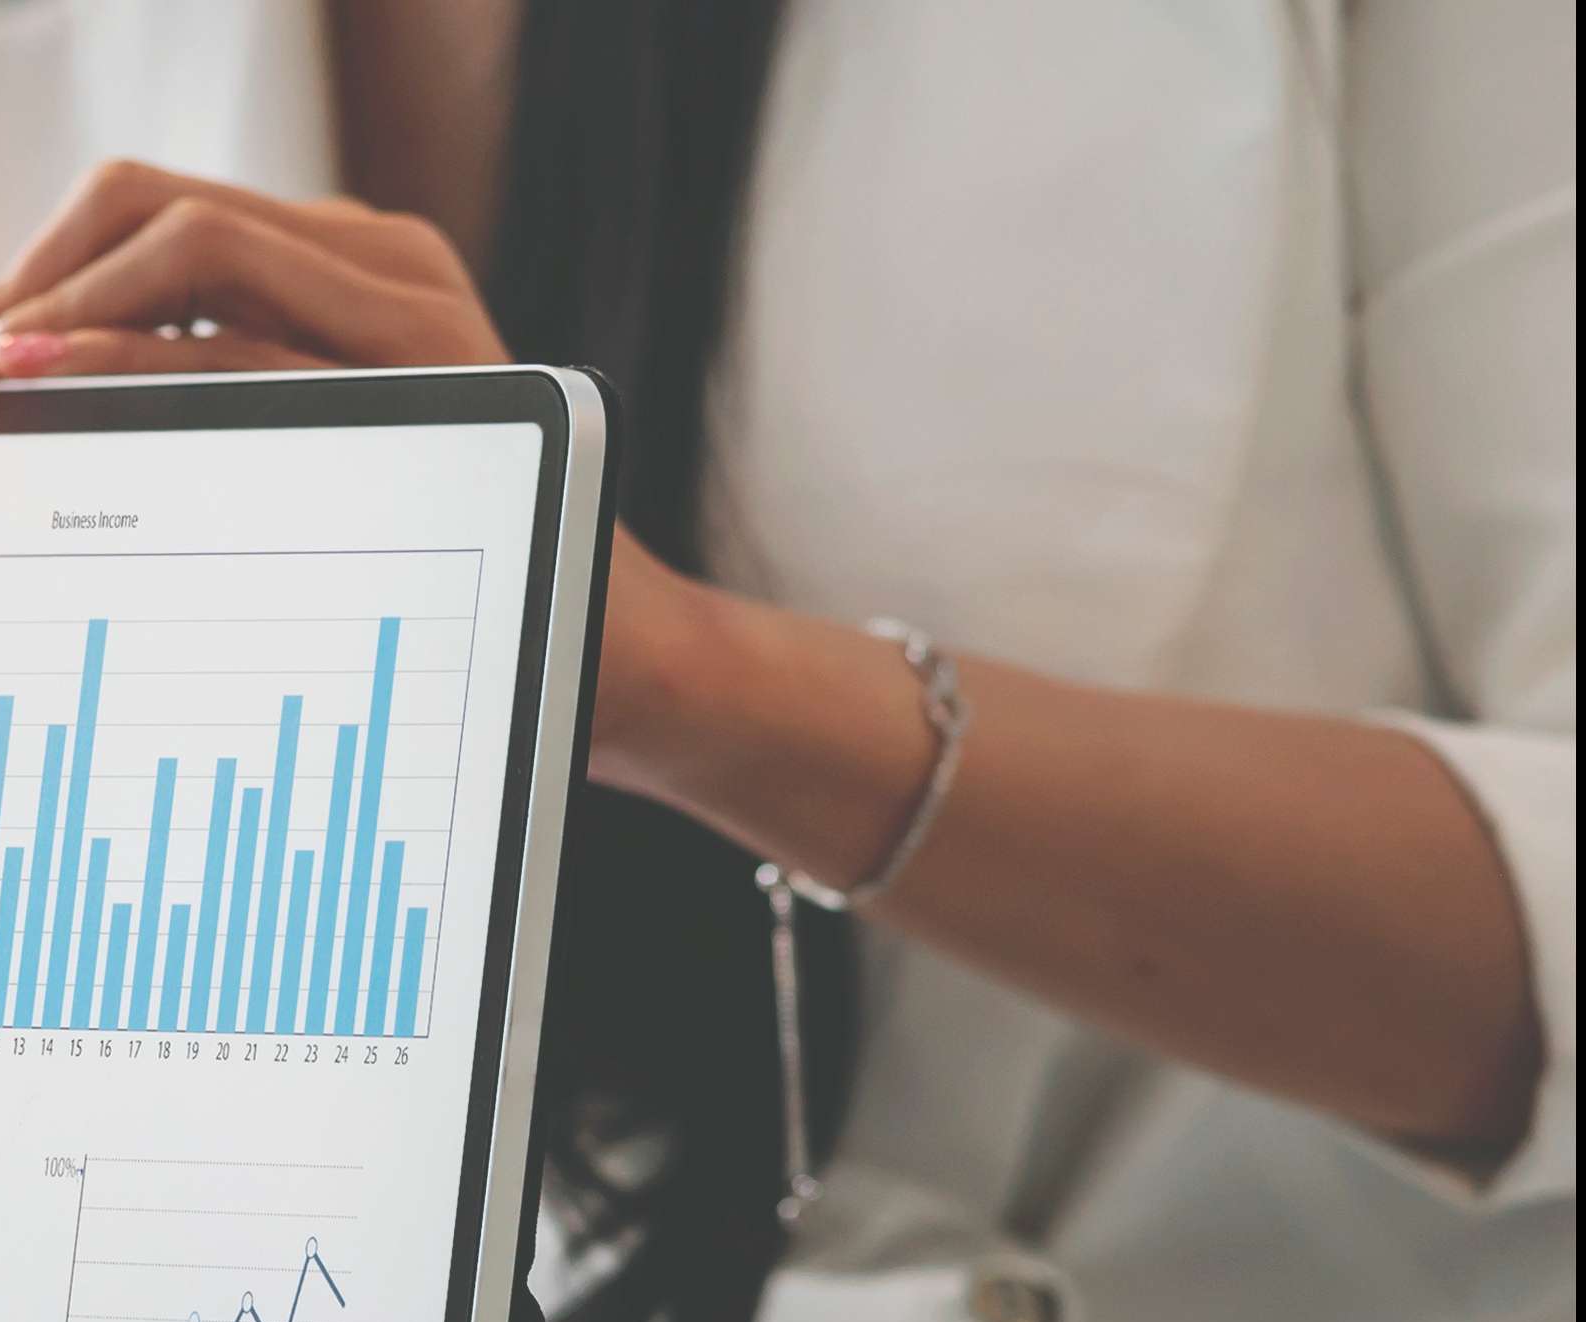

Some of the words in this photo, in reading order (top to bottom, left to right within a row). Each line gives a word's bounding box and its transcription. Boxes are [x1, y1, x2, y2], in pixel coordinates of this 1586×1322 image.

[51, 509, 97, 529] Business
[98, 510, 139, 528] Income
[13, 1037, 25, 1056] 13
[41, 1038, 53, 1056] 14
[70, 1039, 83, 1057] 15
[99, 1040, 112, 1058] 16
[128, 1040, 141, 1058] 17
[157, 1041, 171, 1059] 18
[186, 1042, 199, 1060] 19
[216, 1042, 230, 1060] 20
[244, 1043, 257, 1061] 21
[274, 1044, 288, 1062] 22
[305, 1045, 319, 1063] 23
[335, 1045, 349, 1063] 24
[364, 1046, 378, 1064] 25
[394, 1047, 408, 1065] 26
[44, 1156, 77, 1177] 100%
